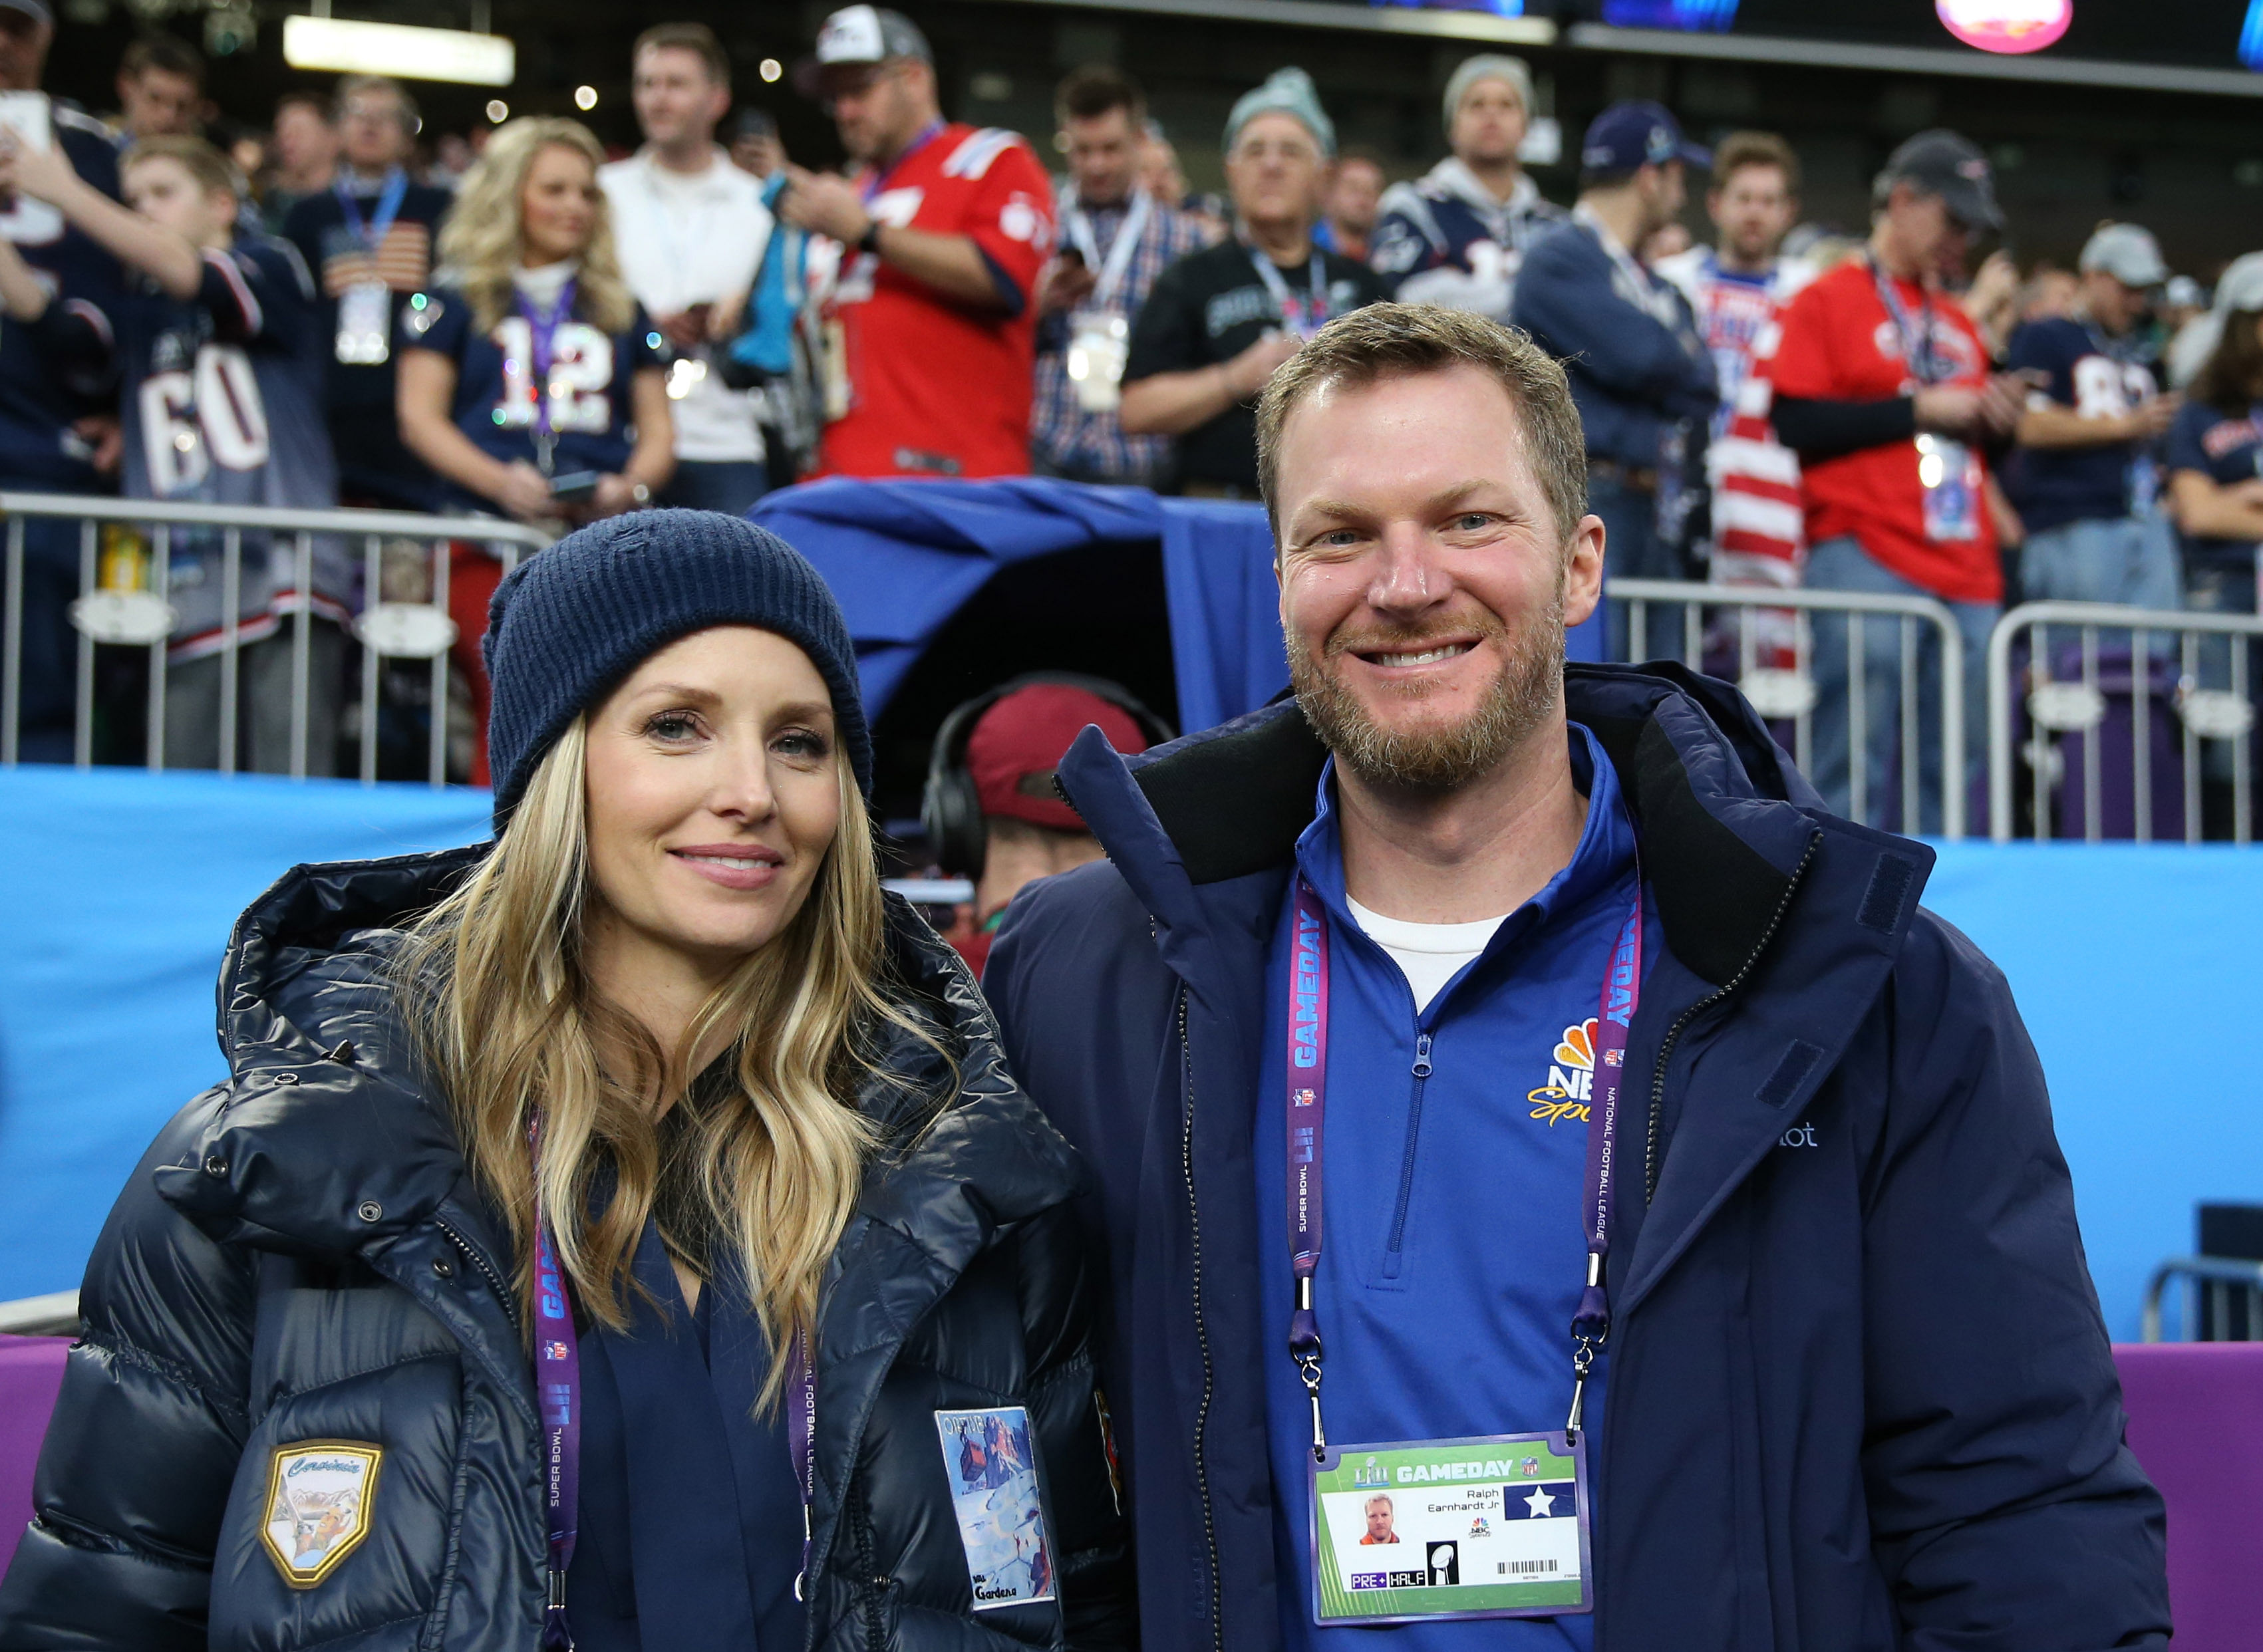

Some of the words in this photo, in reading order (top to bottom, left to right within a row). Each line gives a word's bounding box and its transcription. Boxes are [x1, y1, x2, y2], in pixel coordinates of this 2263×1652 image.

[492, 317, 615, 434] 12
[138, 344, 269, 496] 60
[1294, 908, 1320, 1068] GAMEDAY
[1603, 1087, 1616, 1138] NATIONAL
[1294, 1127, 1314, 1163] LII
[1598, 1141, 1611, 1196] FOOTBALL
[1596, 1199, 1606, 1240] LEAGUE
[545, 1384, 570, 1425] LII
[806, 1385, 815, 1446] FOOTBALL
[552, 1427, 562, 1462] BOWL
[551, 1466, 560, 1507] SUPER
[1397, 1459, 1513, 1483] GAMEDAY
[1428, 1501, 1484, 1512] Earnhardt
[1487, 1500, 1499, 1509] Jr
[1467, 1489, 1499, 1499] Ralph
[975, 1585, 1016, 1600] Gardena
[1390, 1572, 1424, 1586] HALF
